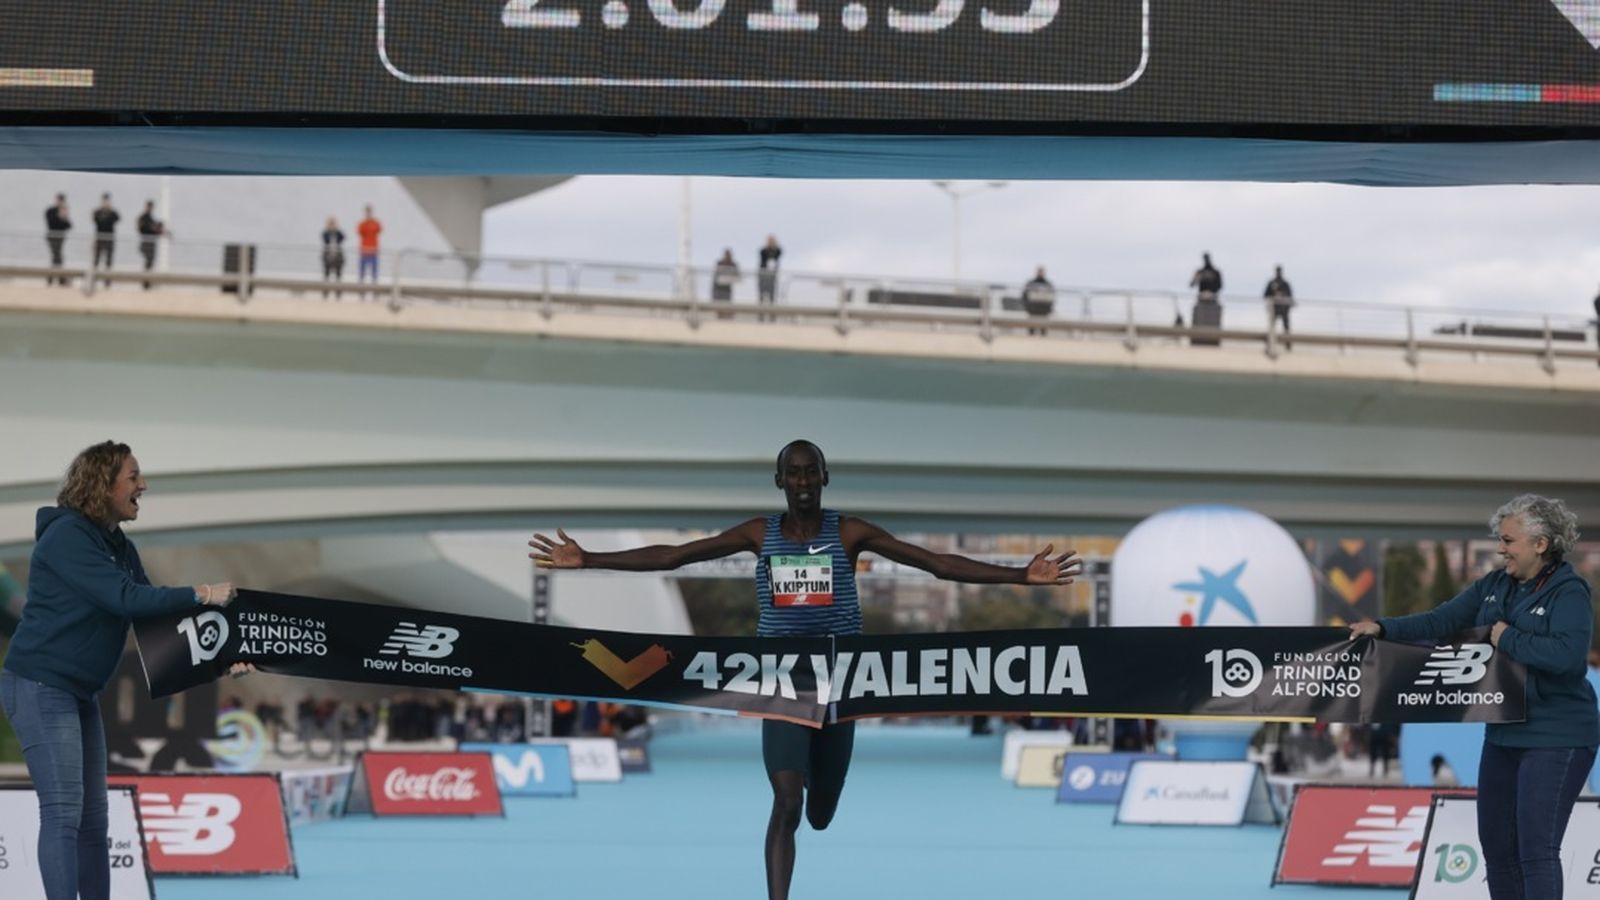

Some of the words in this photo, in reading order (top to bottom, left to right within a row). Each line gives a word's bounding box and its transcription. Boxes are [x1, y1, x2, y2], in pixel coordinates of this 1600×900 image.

[794, 569, 807, 580] 14
[783, 581, 830, 593] KIPTUM
[239, 612, 325, 629] FUNDACIÓN
[238, 624, 327, 642] TRINIDAD
[238, 640, 328, 656] ALFONSO
[363, 657, 399, 671] new
[401, 659, 473, 677] balance
[683, 651, 799, 700] 42K
[810, 645, 1089, 705] VALENCIA
[1273, 664, 1362, 682] TRINIDAD
[1271, 681, 1362, 698] ALFONSO
[1397, 692, 1432, 706] new
[1435, 689, 1505, 705] balance
[115, 841, 131, 850] del
